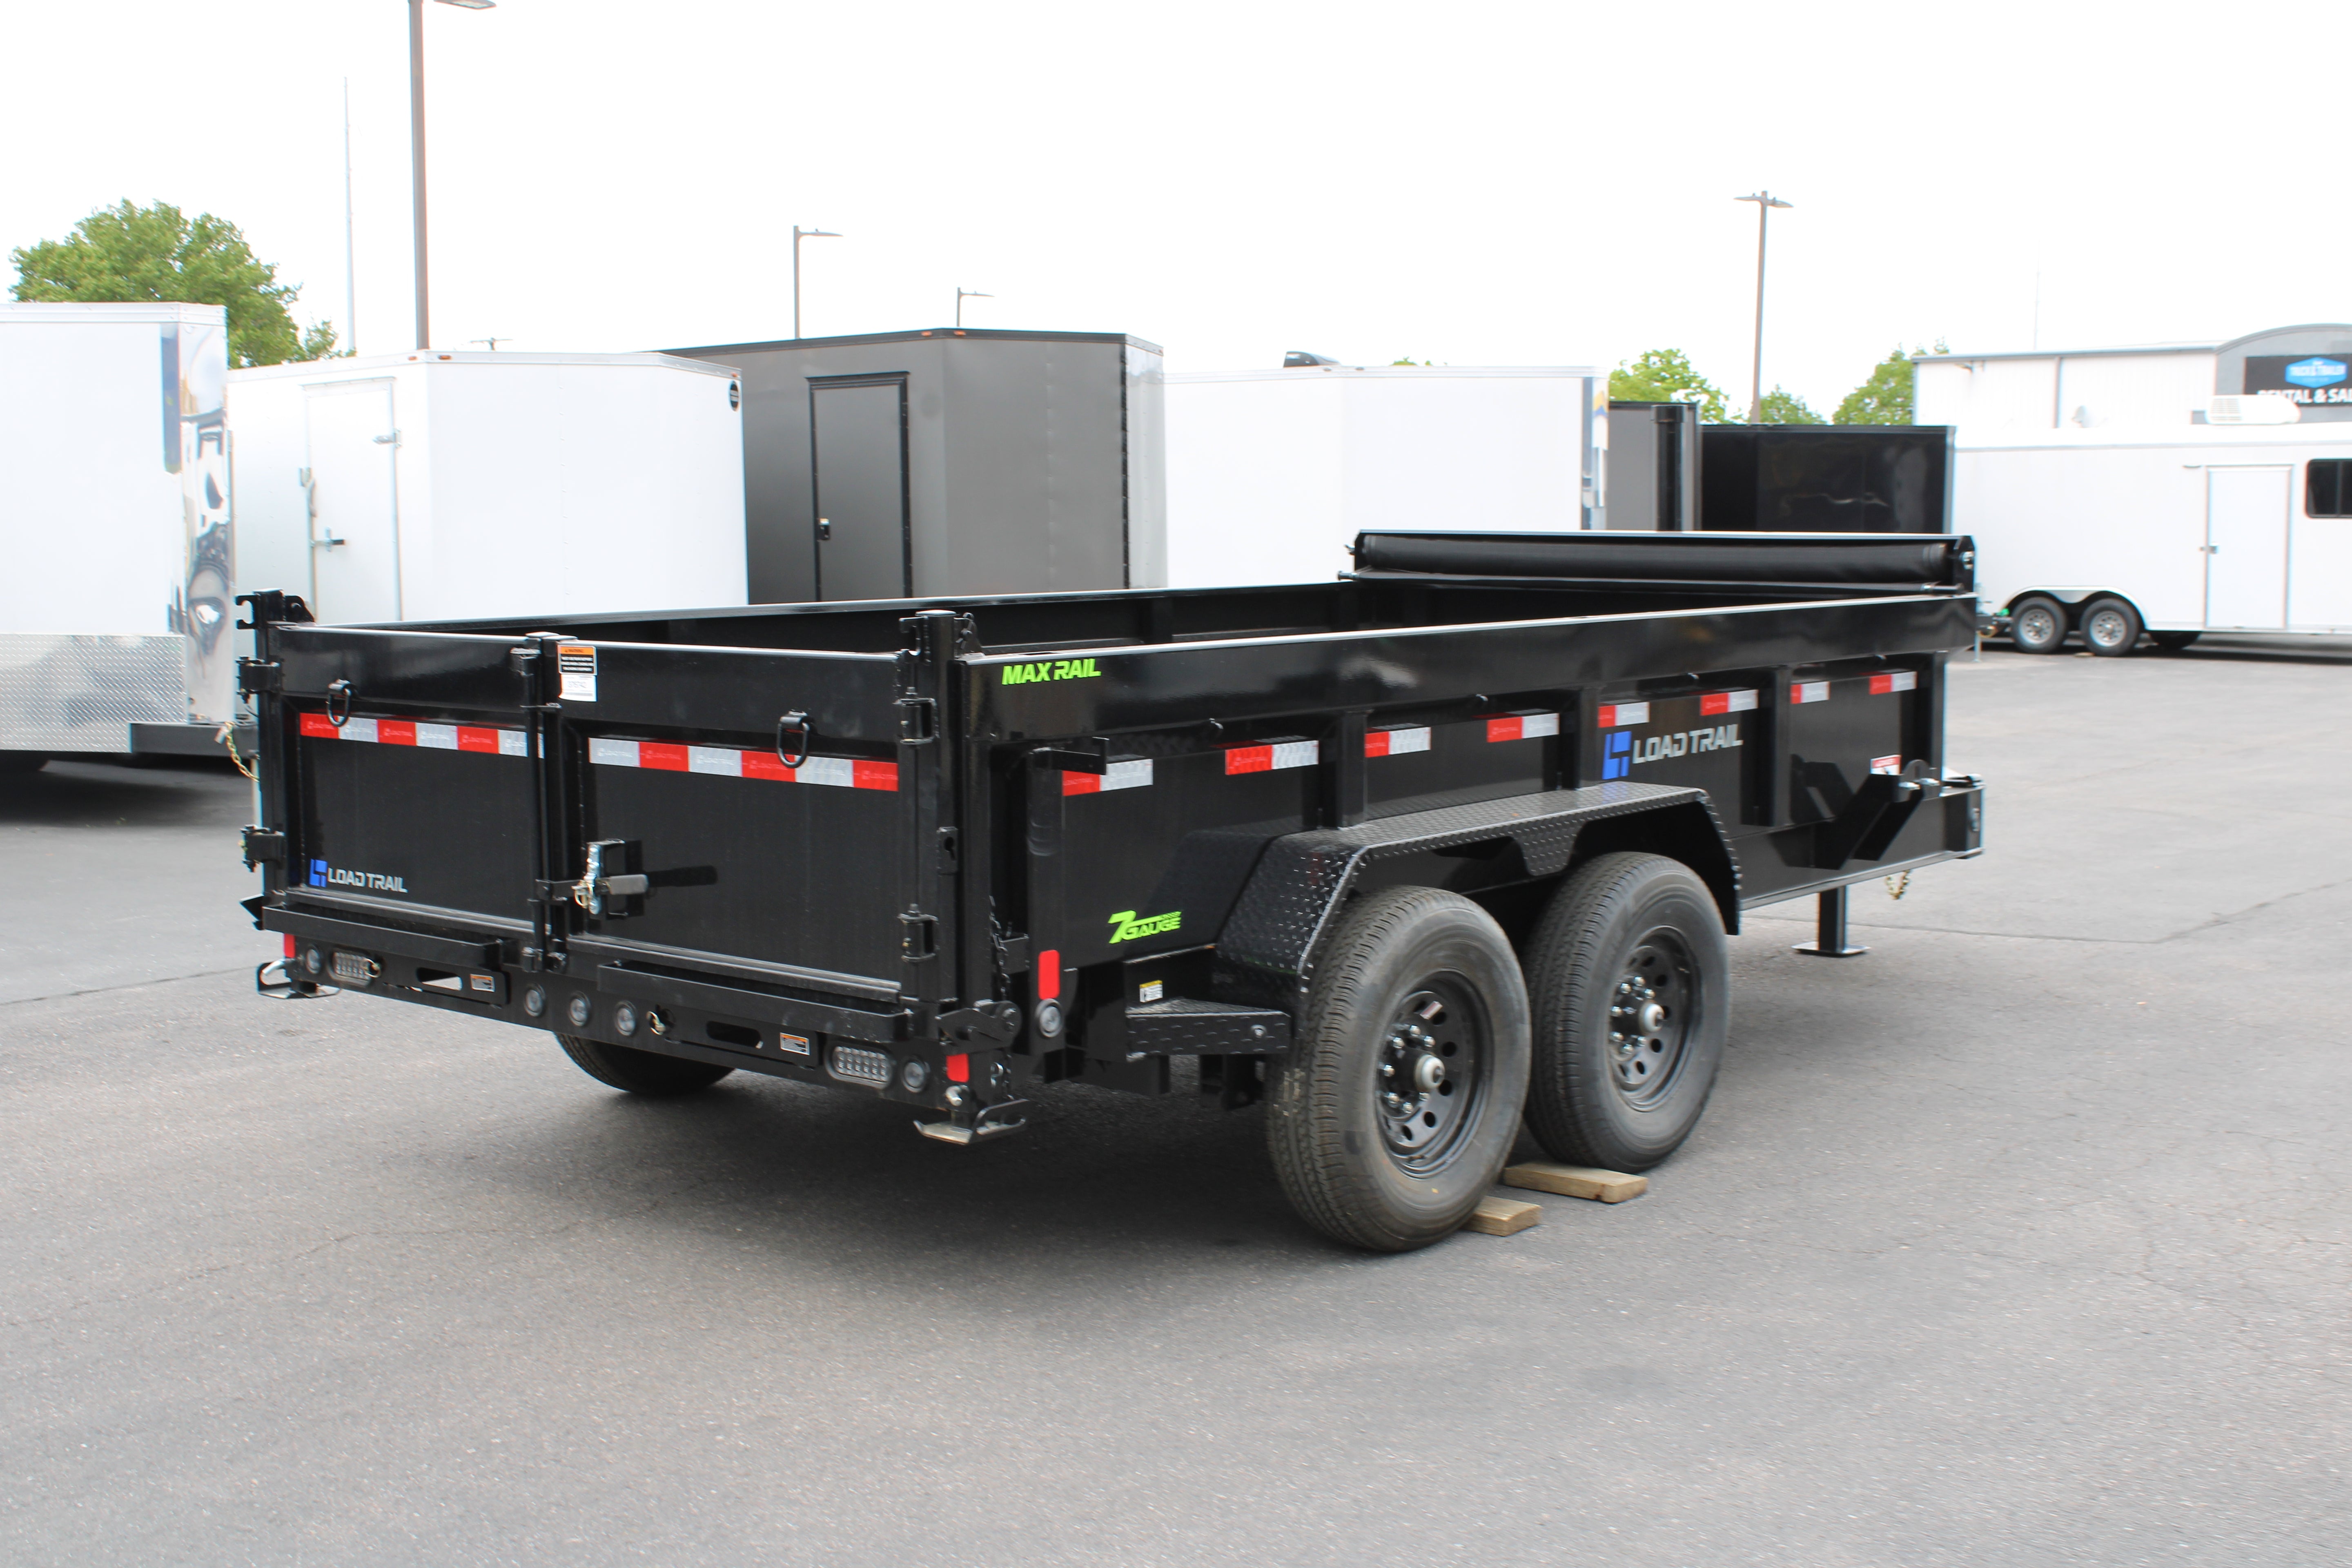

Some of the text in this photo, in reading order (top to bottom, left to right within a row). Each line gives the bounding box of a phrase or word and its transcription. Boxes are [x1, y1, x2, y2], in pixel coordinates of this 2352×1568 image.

[2313, 388, 2328, 403] &
[1002, 658, 1102, 686] MAX RAIL
[1121, 917, 1181, 940] GAUGE
